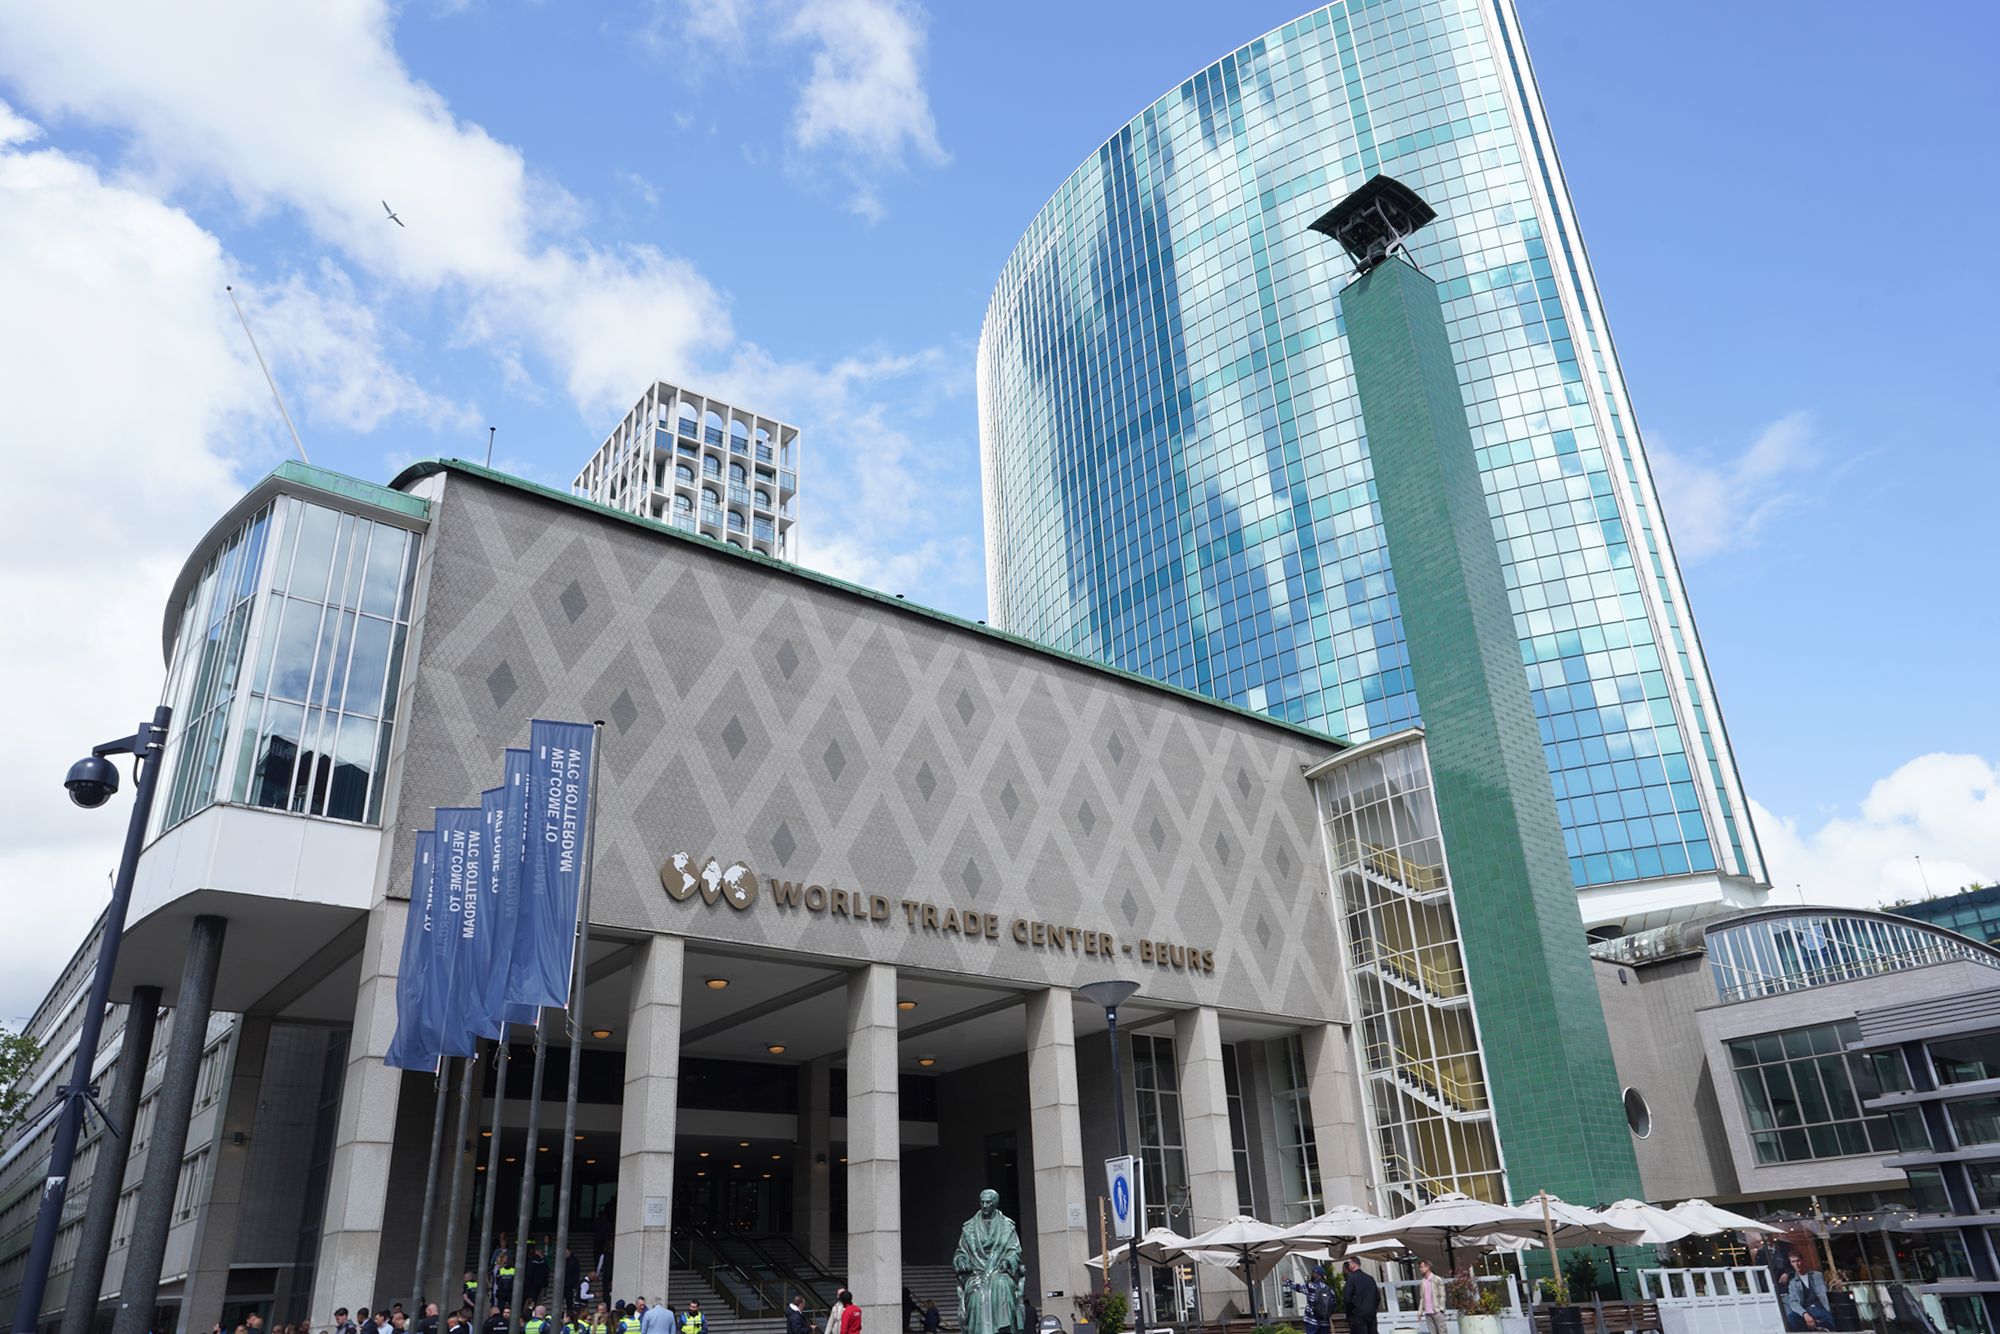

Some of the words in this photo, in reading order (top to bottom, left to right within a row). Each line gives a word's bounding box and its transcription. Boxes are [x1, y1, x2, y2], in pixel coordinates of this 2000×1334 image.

[770, 878, 891, 921] WORLD
[901, 899, 1001, 940] TRADE
[1012, 918, 1116, 957] CENTER
[1140, 939, 1216, 973] BEURS
